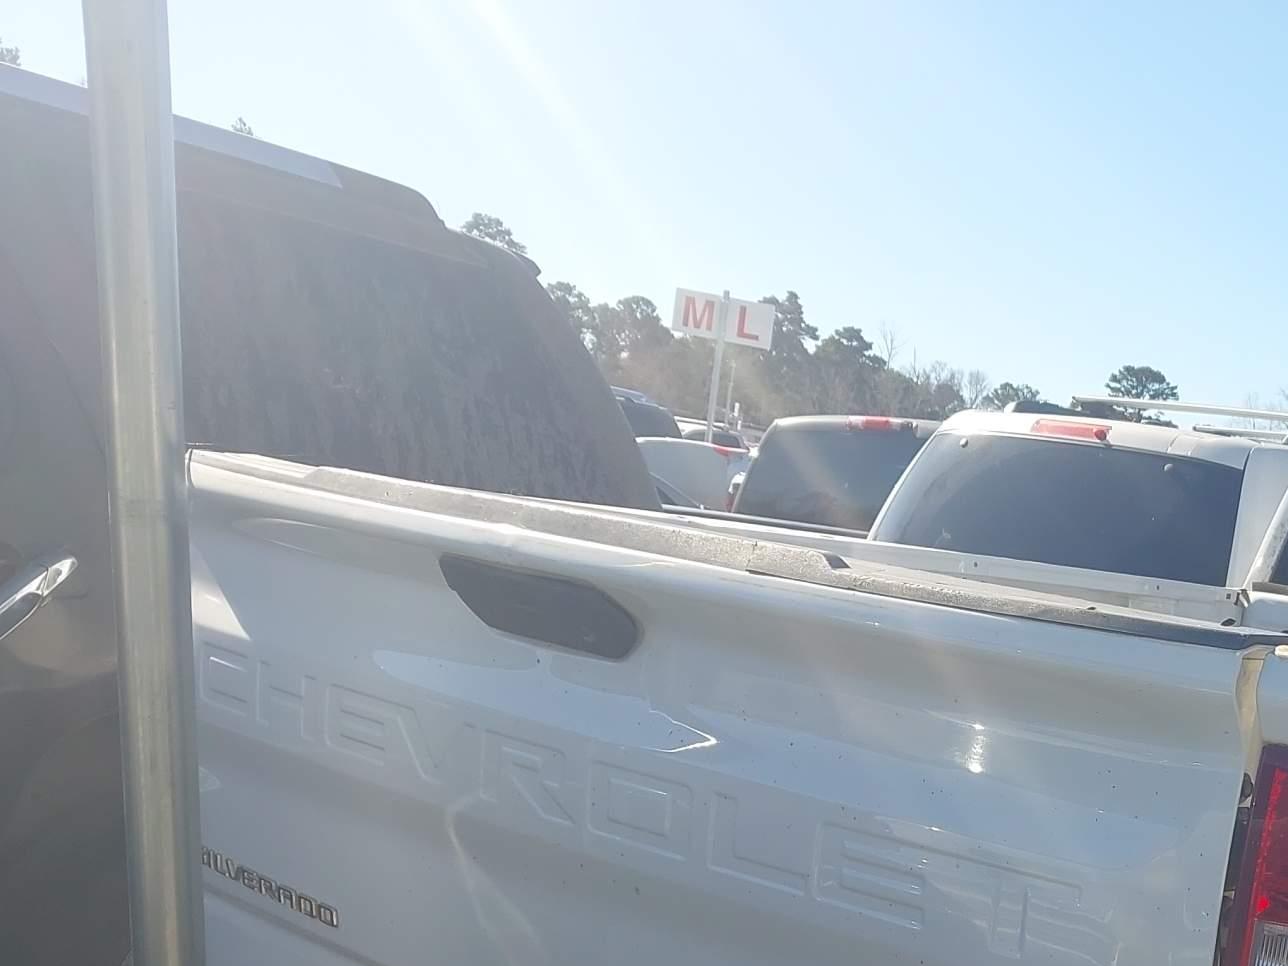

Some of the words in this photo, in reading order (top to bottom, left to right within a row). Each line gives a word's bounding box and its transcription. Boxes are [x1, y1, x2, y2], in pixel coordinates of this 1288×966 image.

[682, 296, 715, 332] M
[736, 305, 759, 341] L
[199, 641, 1086, 958] CHEVROLET
